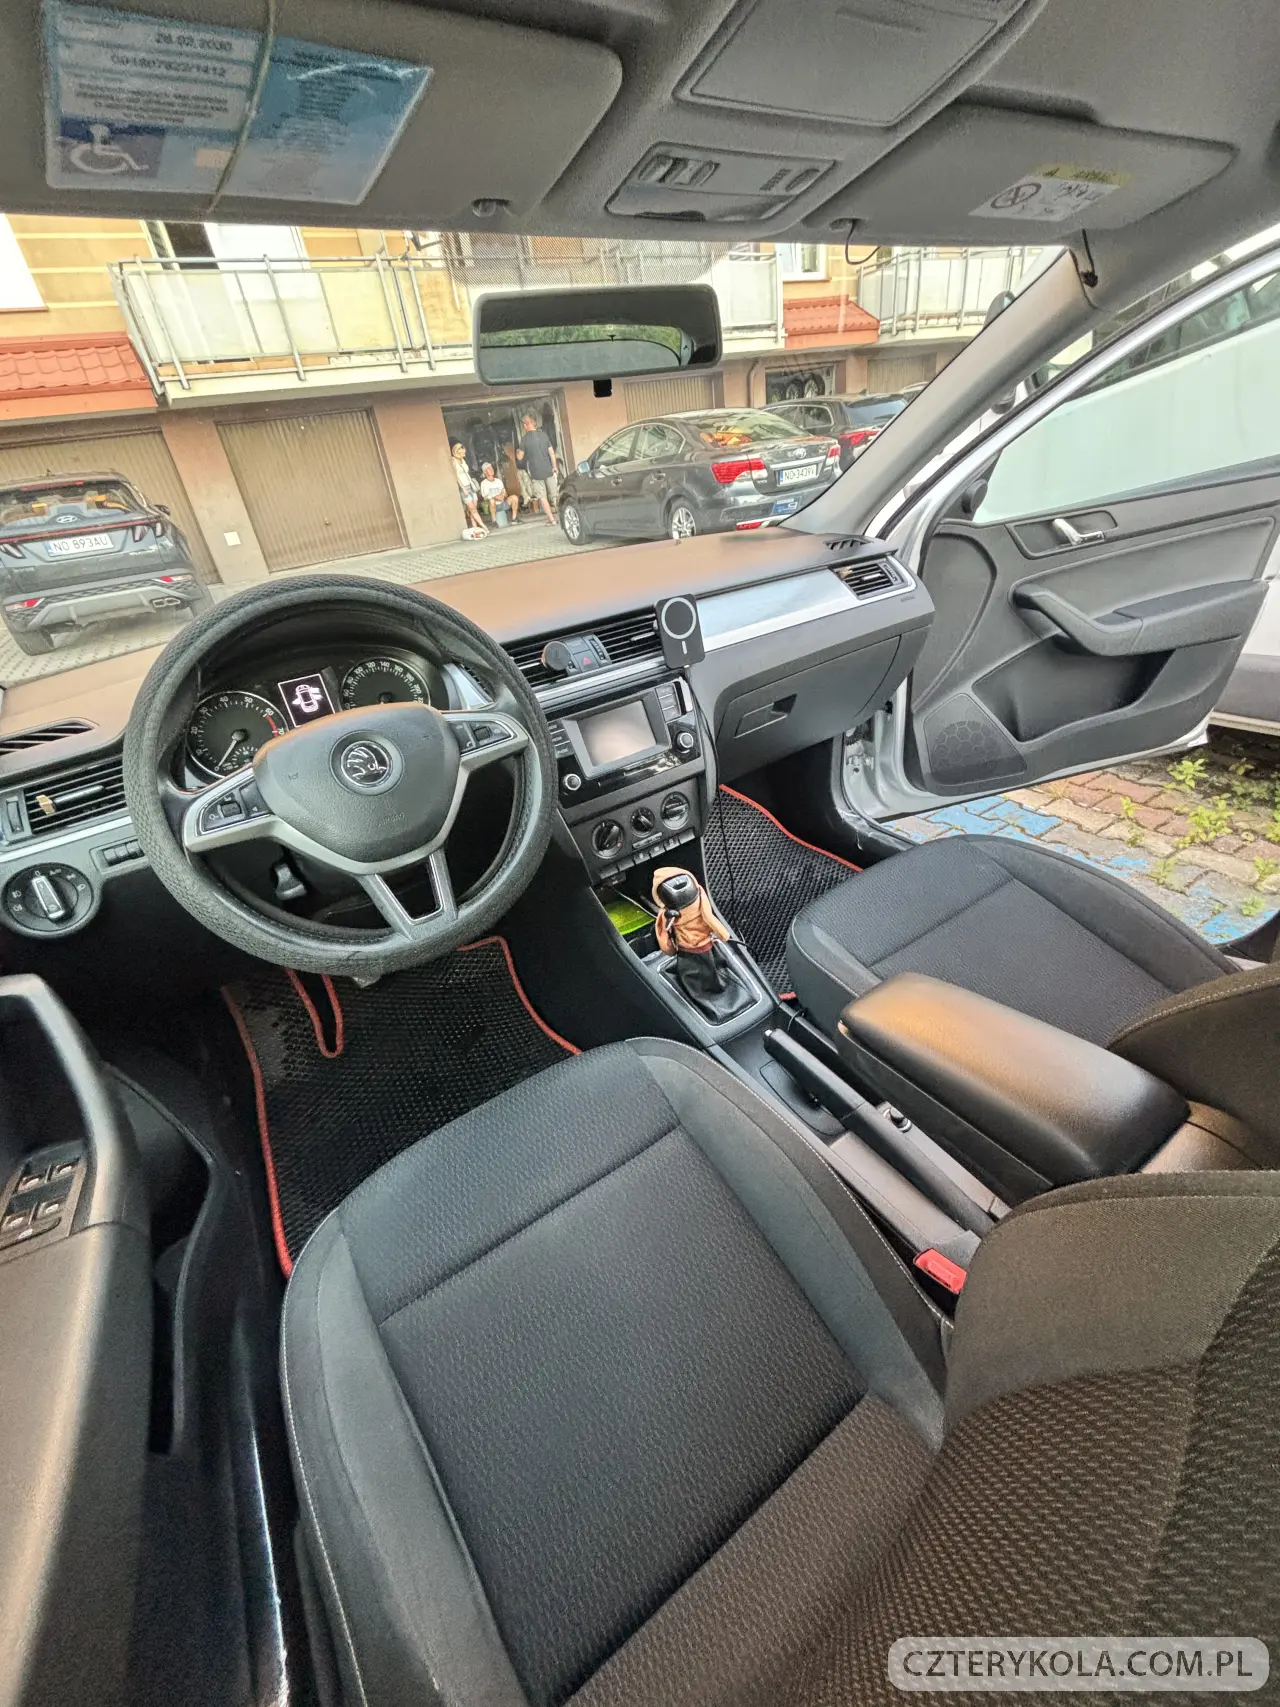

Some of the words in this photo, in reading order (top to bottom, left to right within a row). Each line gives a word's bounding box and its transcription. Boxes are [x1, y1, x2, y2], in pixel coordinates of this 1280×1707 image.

[72, 536, 108, 549] 893AU
[244, 696, 253, 704] 50
[265, 707, 274, 716] 60
[191, 726, 198, 734] 20
